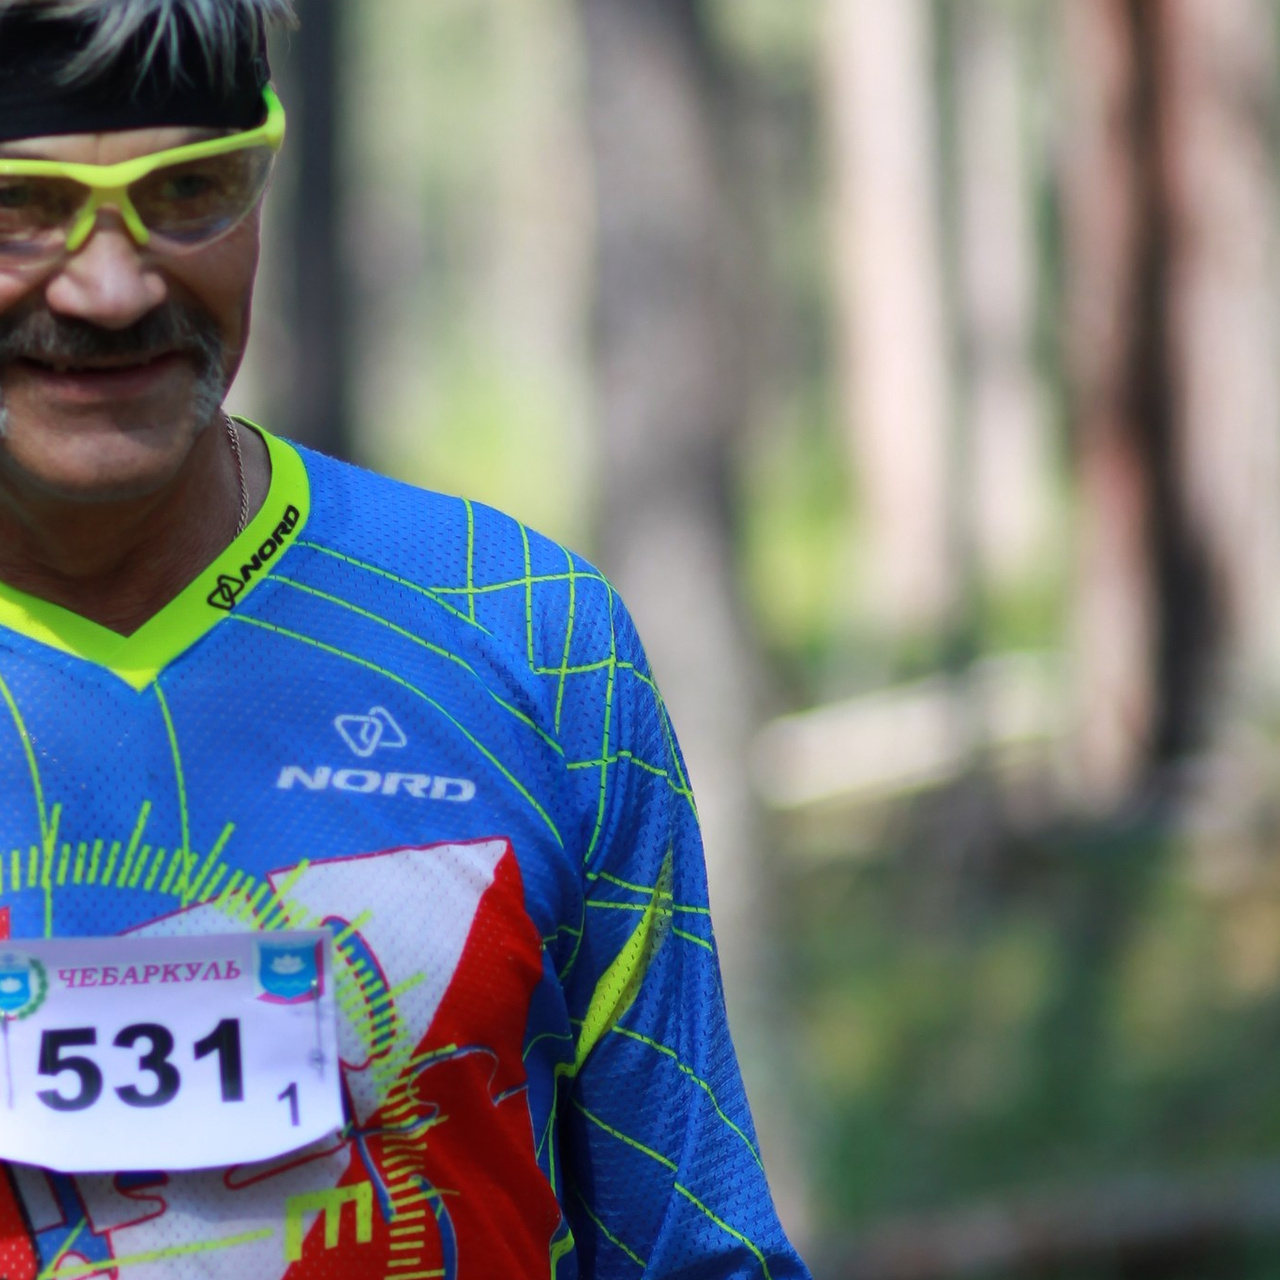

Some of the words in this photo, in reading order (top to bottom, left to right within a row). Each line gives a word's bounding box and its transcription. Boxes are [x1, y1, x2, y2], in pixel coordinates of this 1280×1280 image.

[240, 504, 301, 584] NORD
[276, 765, 477, 803] NORD
[57, 959, 242, 989] ЧЕБАРКУЛЬ
[35, 1018, 245, 1112] 531
[277, 1081, 301, 1127] 1
